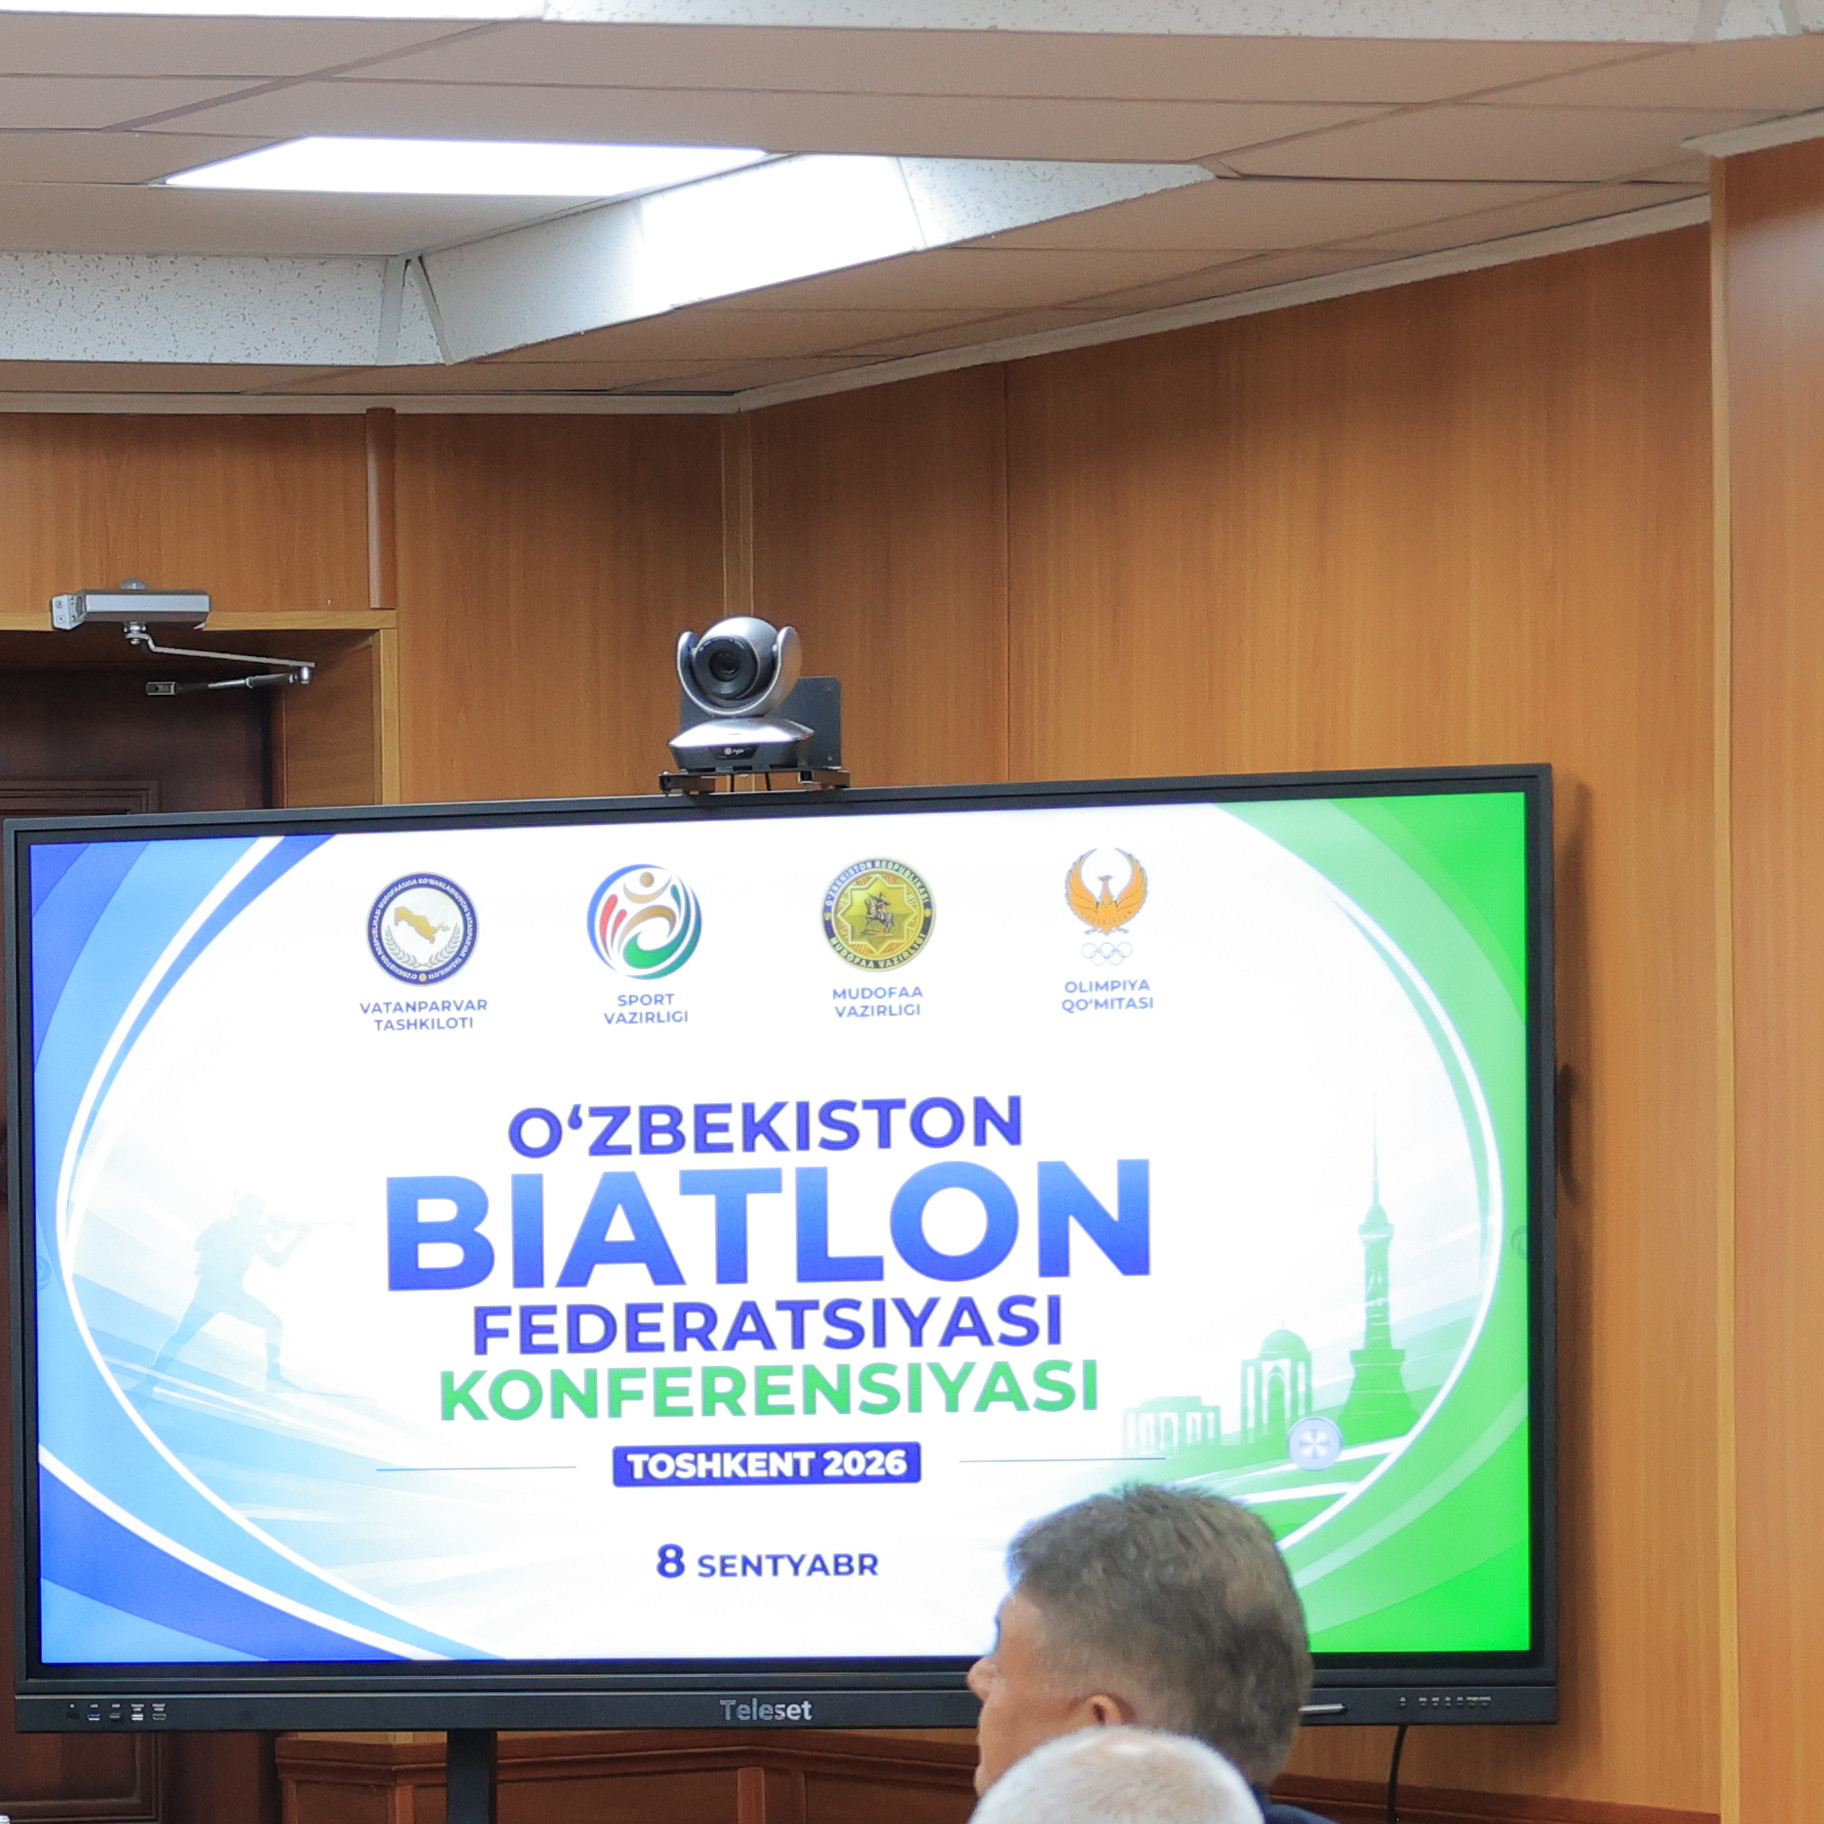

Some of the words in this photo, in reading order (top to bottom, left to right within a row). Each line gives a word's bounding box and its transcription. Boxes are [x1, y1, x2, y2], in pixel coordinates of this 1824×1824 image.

[832, 986, 924, 1000] MUDOFAA
[1064, 979, 1151, 993] OLIMPIYA
[359, 999, 488, 1014] VATANPARVAR
[617, 993, 675, 1006] SPORT
[1061, 997, 1154, 1013] QO‘MITASI
[603, 1010, 689, 1024] VAZIRLIGI
[834, 1003, 921, 1018] VAZIRLIGI
[374, 1017, 473, 1031] TASHKILOTI
[507, 1095, 1023, 1159] O‘ZBEKISTON
[385, 1158, 1152, 1292] BIATLON
[473, 1294, 1063, 1356] FEDERATSIYASI
[439, 1359, 1099, 1421] KONFERENSIYASI
[626, 1451, 816, 1480] TOSHKENT
[822, 1449, 908, 1477] 2026
[656, 1543, 686, 1579] 8
[697, 1553, 879, 1578] SENTYABR
[719, 1698, 813, 1721] Teleset
